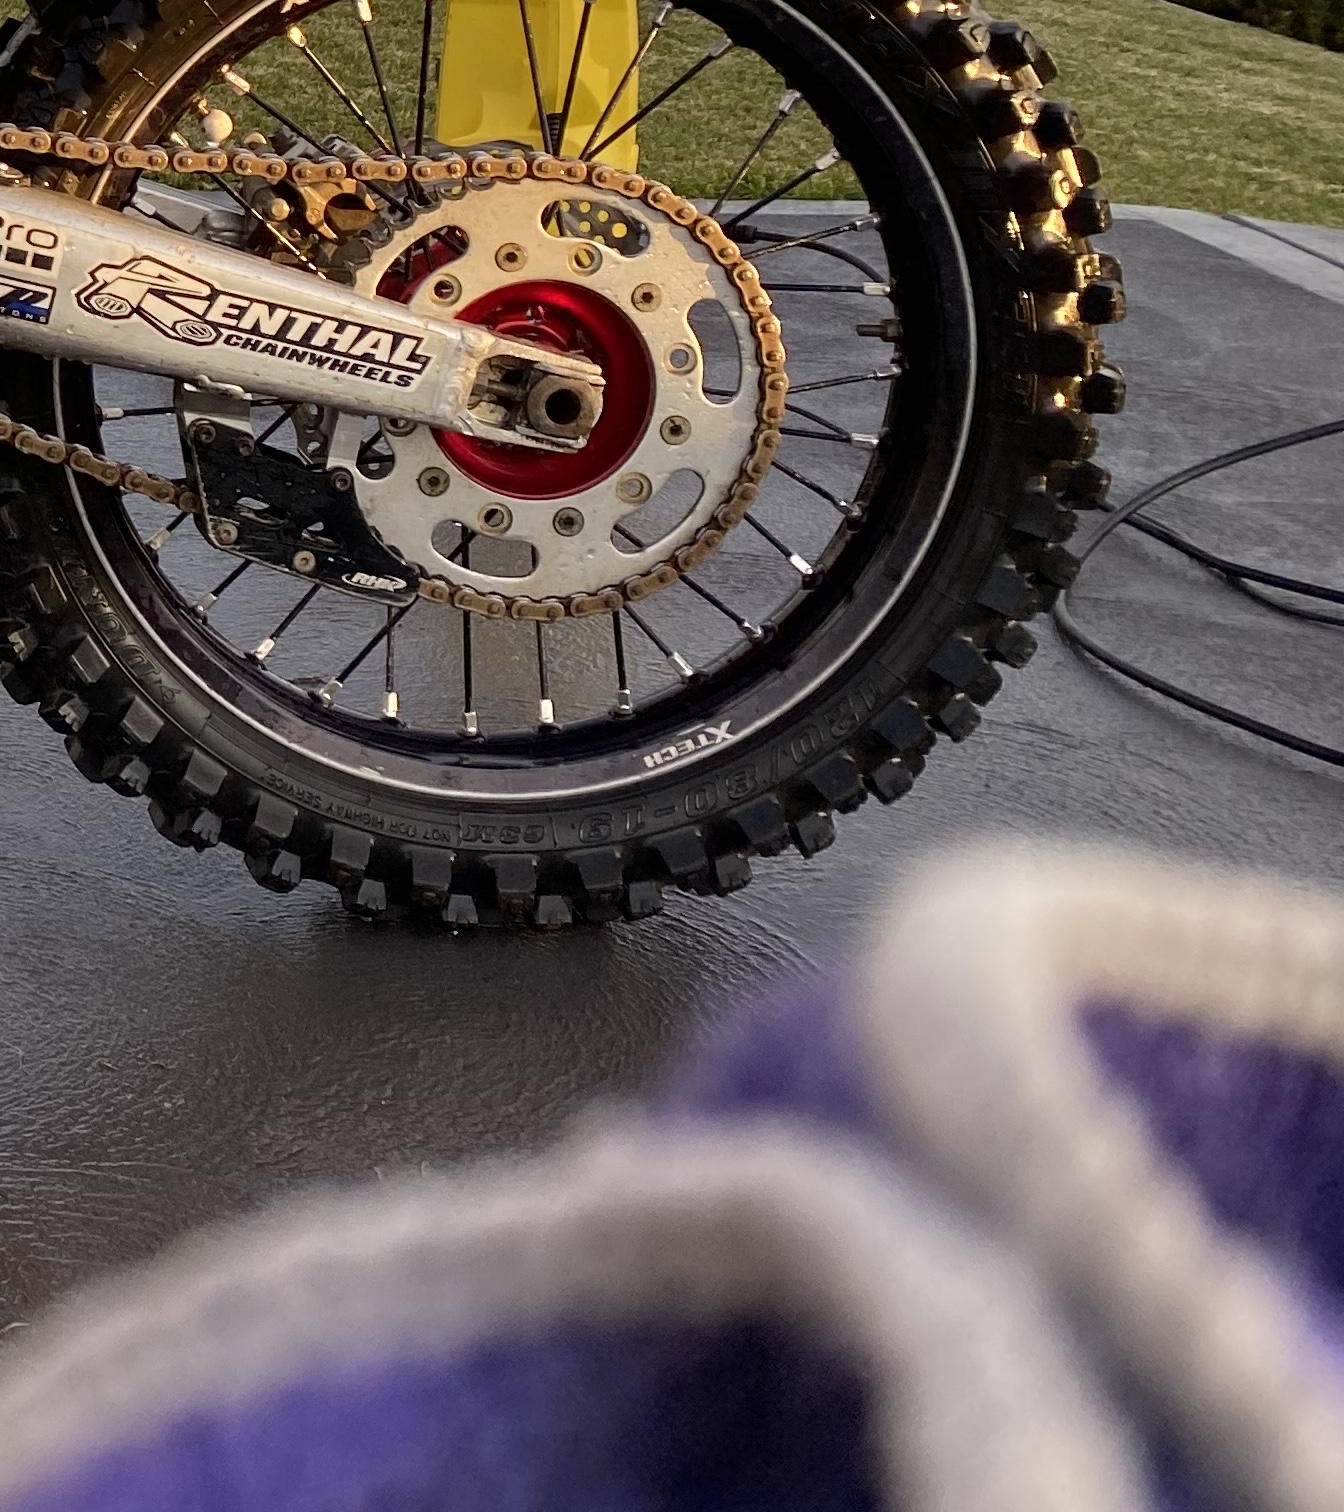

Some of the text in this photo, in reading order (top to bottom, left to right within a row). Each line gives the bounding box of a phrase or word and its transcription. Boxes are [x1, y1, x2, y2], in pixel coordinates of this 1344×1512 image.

[75, 255, 433, 374] RENTHAL
[223, 333, 416, 389] CHAINWHEELS
[643, 720, 735, 768] XTECH
